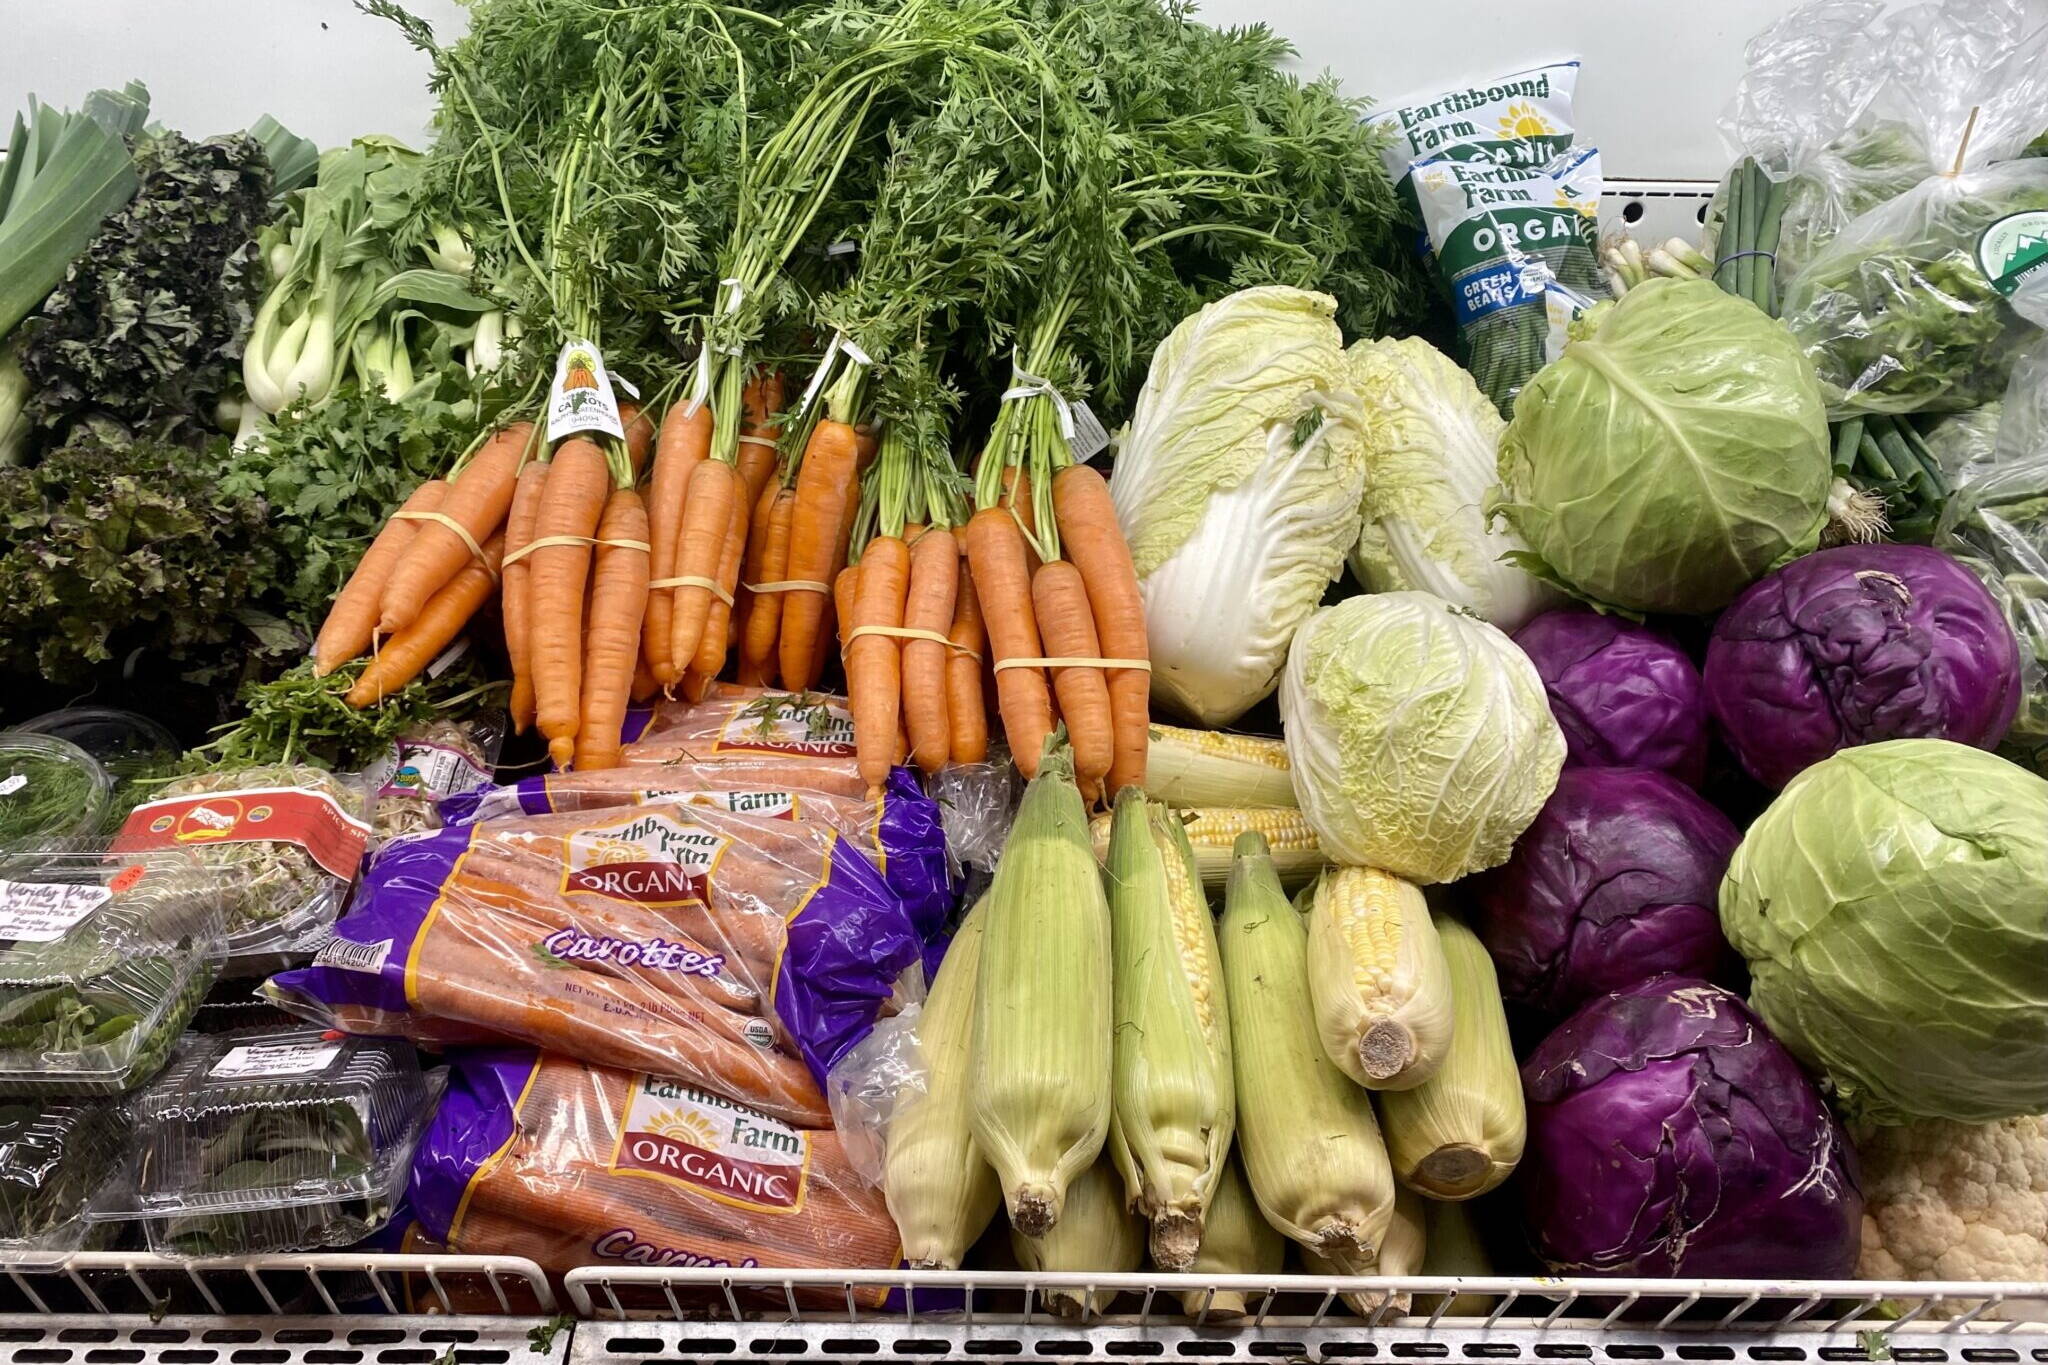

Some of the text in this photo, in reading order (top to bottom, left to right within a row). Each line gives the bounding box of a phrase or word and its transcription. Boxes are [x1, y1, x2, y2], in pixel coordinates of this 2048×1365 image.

[1397, 73, 1550, 130] Earthbound
[1463, 270, 1513, 298] GREEN
[321, 803, 349, 831] SPICY
[544, 927, 724, 976] Carottes
[750, 1025, 769, 1034] USDA
[632, 1139, 788, 1200] ORGANIC
